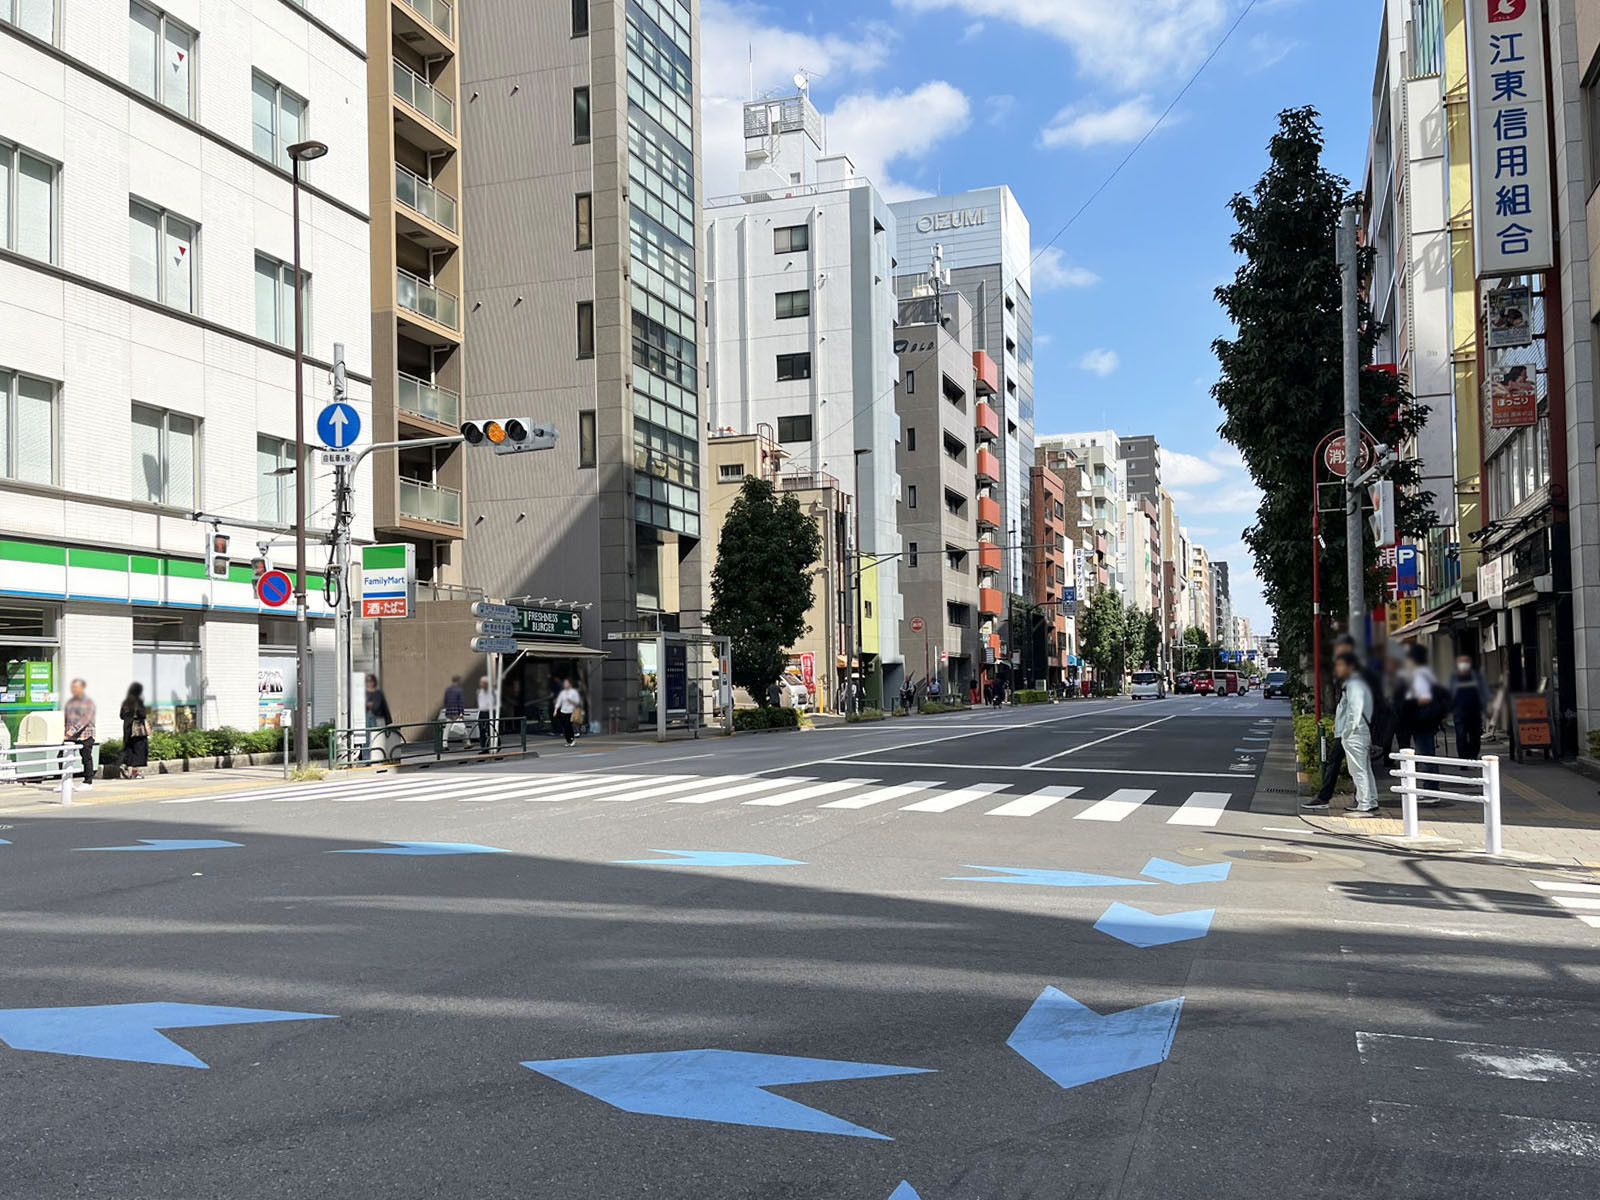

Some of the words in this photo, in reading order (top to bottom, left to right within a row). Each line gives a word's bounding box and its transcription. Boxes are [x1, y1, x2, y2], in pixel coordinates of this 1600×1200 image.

[1488, 32, 1533, 256] 江東信用組合
[916, 208, 985, 234] OIZUMI
[1497, 397, 1529, 406] ほっこり
[1398, 549, 1415, 564] P
[364, 576, 405, 586] FamilyMart
[367, 601, 405, 615] 酒・たばこ
[528, 611, 558, 623] FRESHNESS
[532, 622, 555, 632] BURGER
